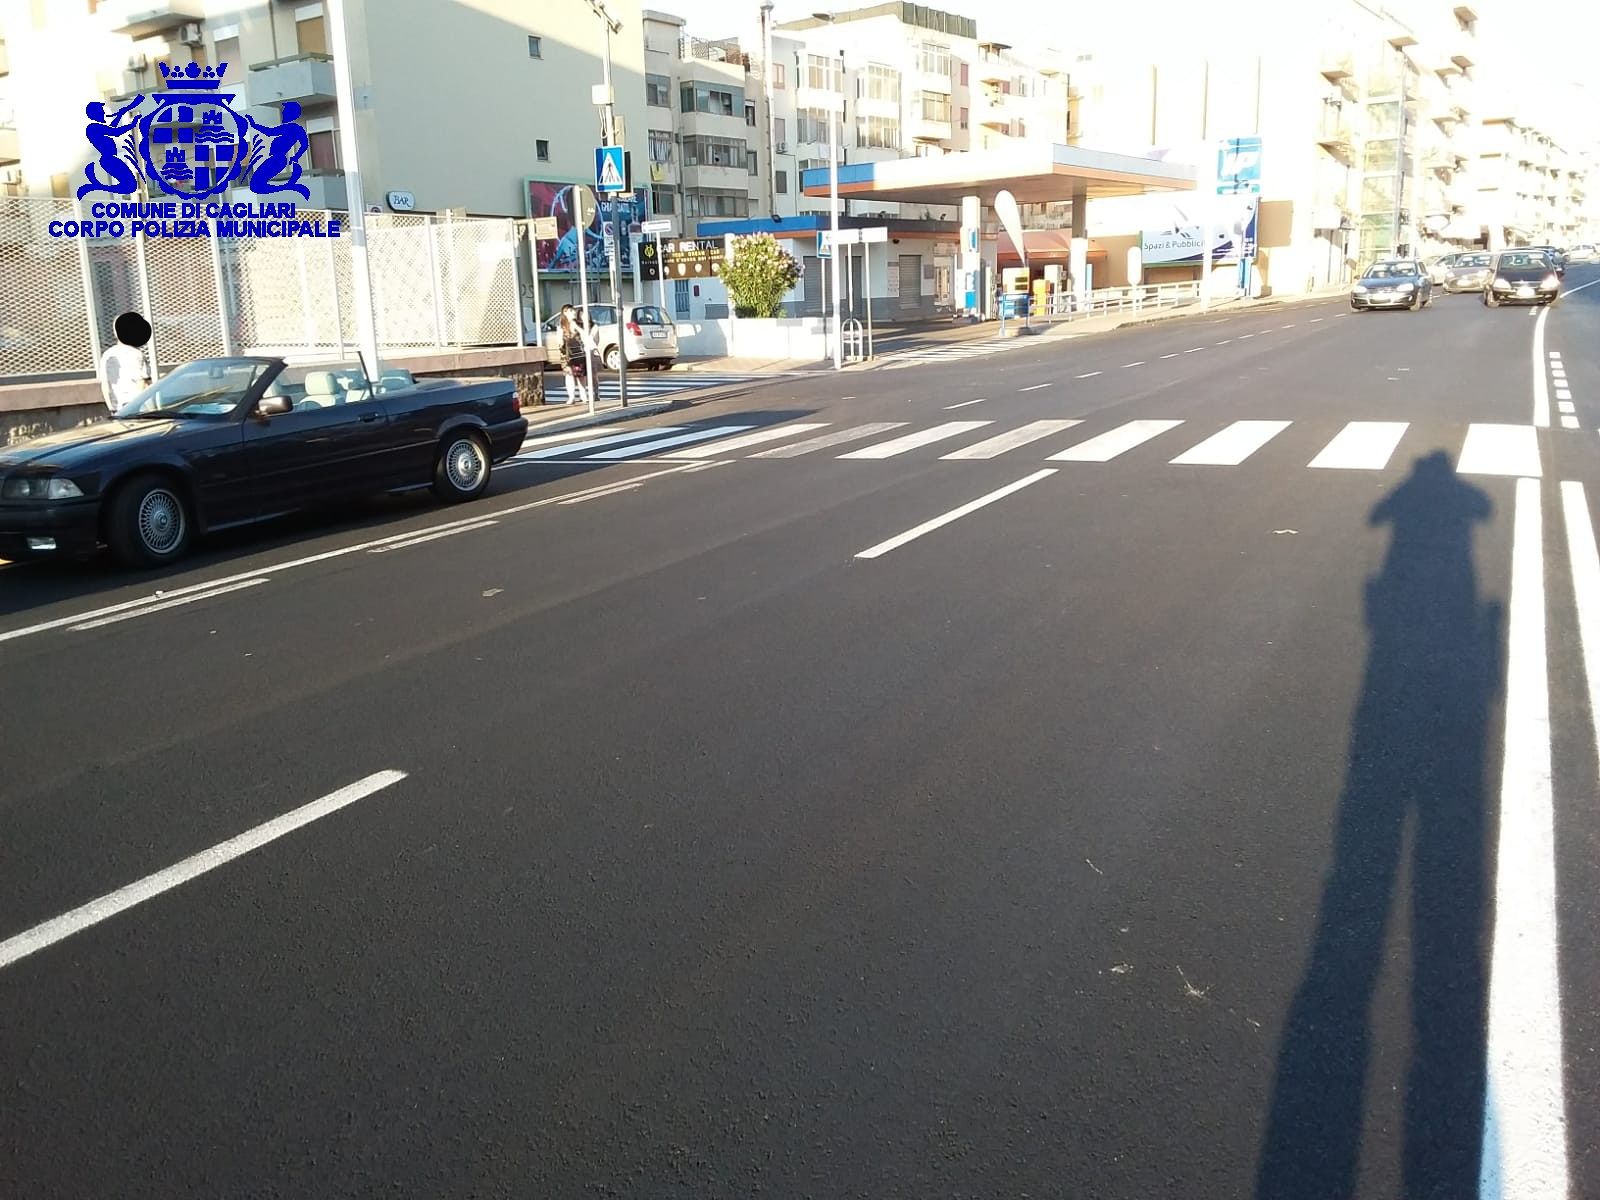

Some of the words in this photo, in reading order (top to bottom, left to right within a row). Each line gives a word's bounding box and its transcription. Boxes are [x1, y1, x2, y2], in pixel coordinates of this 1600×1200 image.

[393, 195, 411, 207] BAR
[680, 240, 718, 252] RENTAL
[1144, 240, 1165, 251] Spazi
[1172, 240, 1204, 249] Pubblici
